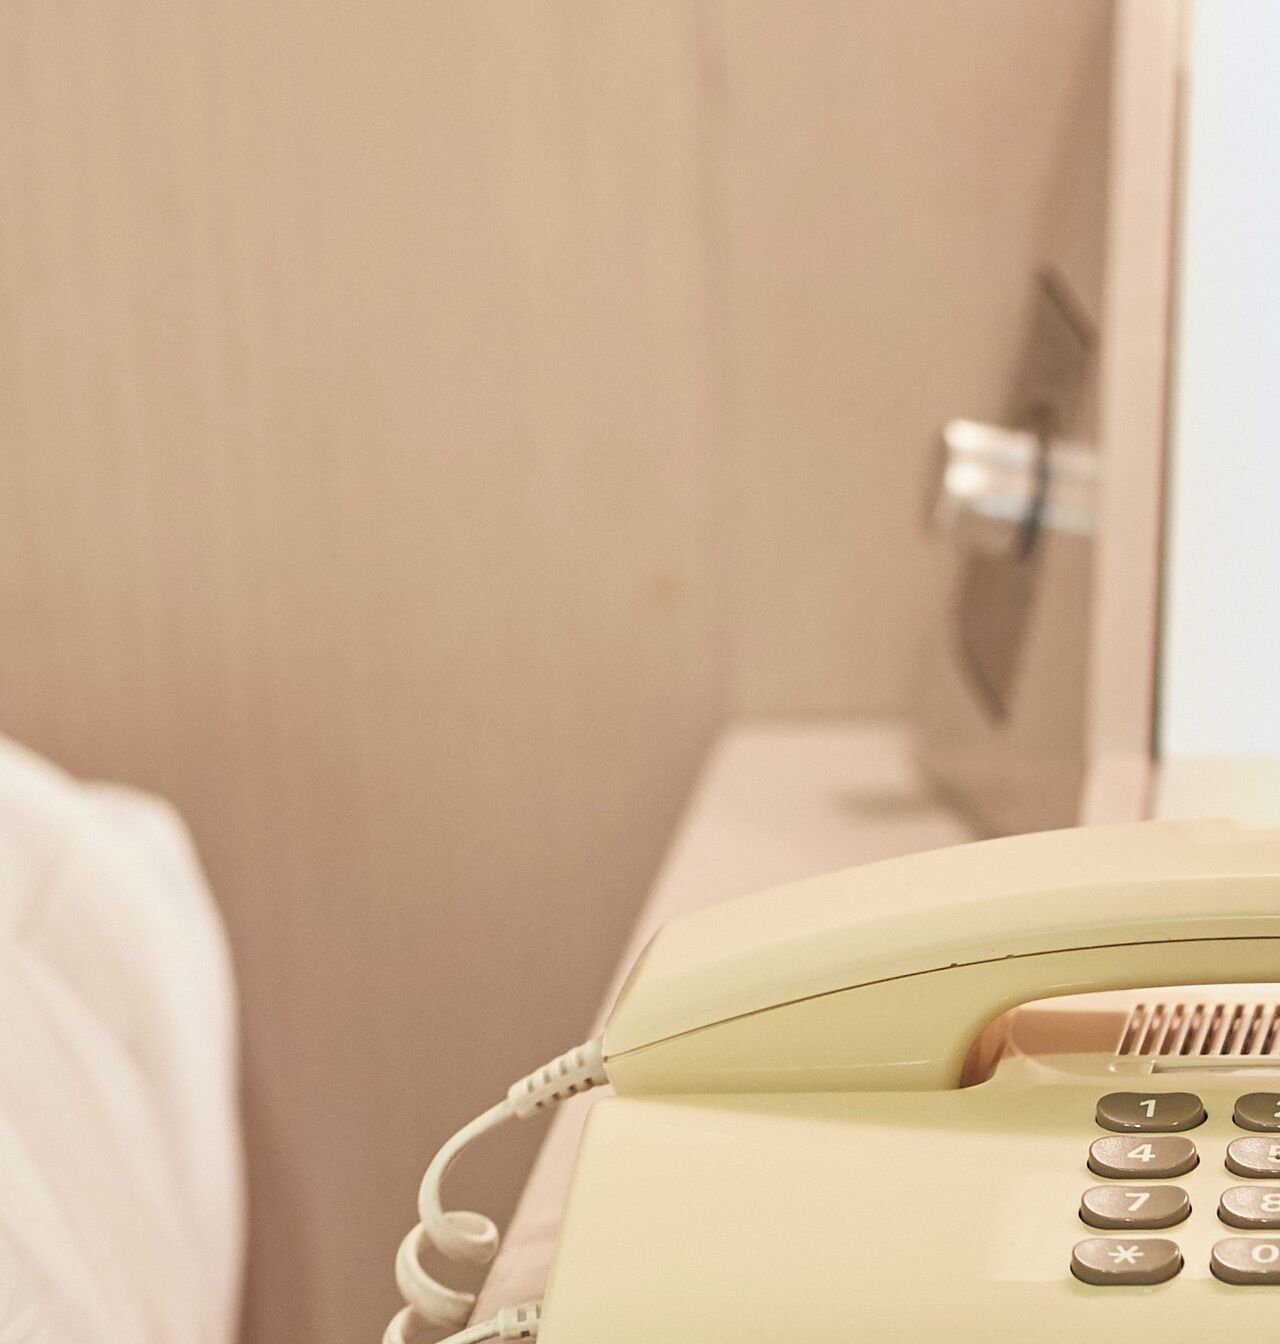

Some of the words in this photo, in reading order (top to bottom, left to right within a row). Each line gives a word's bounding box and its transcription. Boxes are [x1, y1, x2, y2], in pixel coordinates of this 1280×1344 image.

[1139, 1099, 1157, 1118] 1
[1127, 1143, 1156, 1162] 4
[1124, 1192, 1150, 1212] 7
